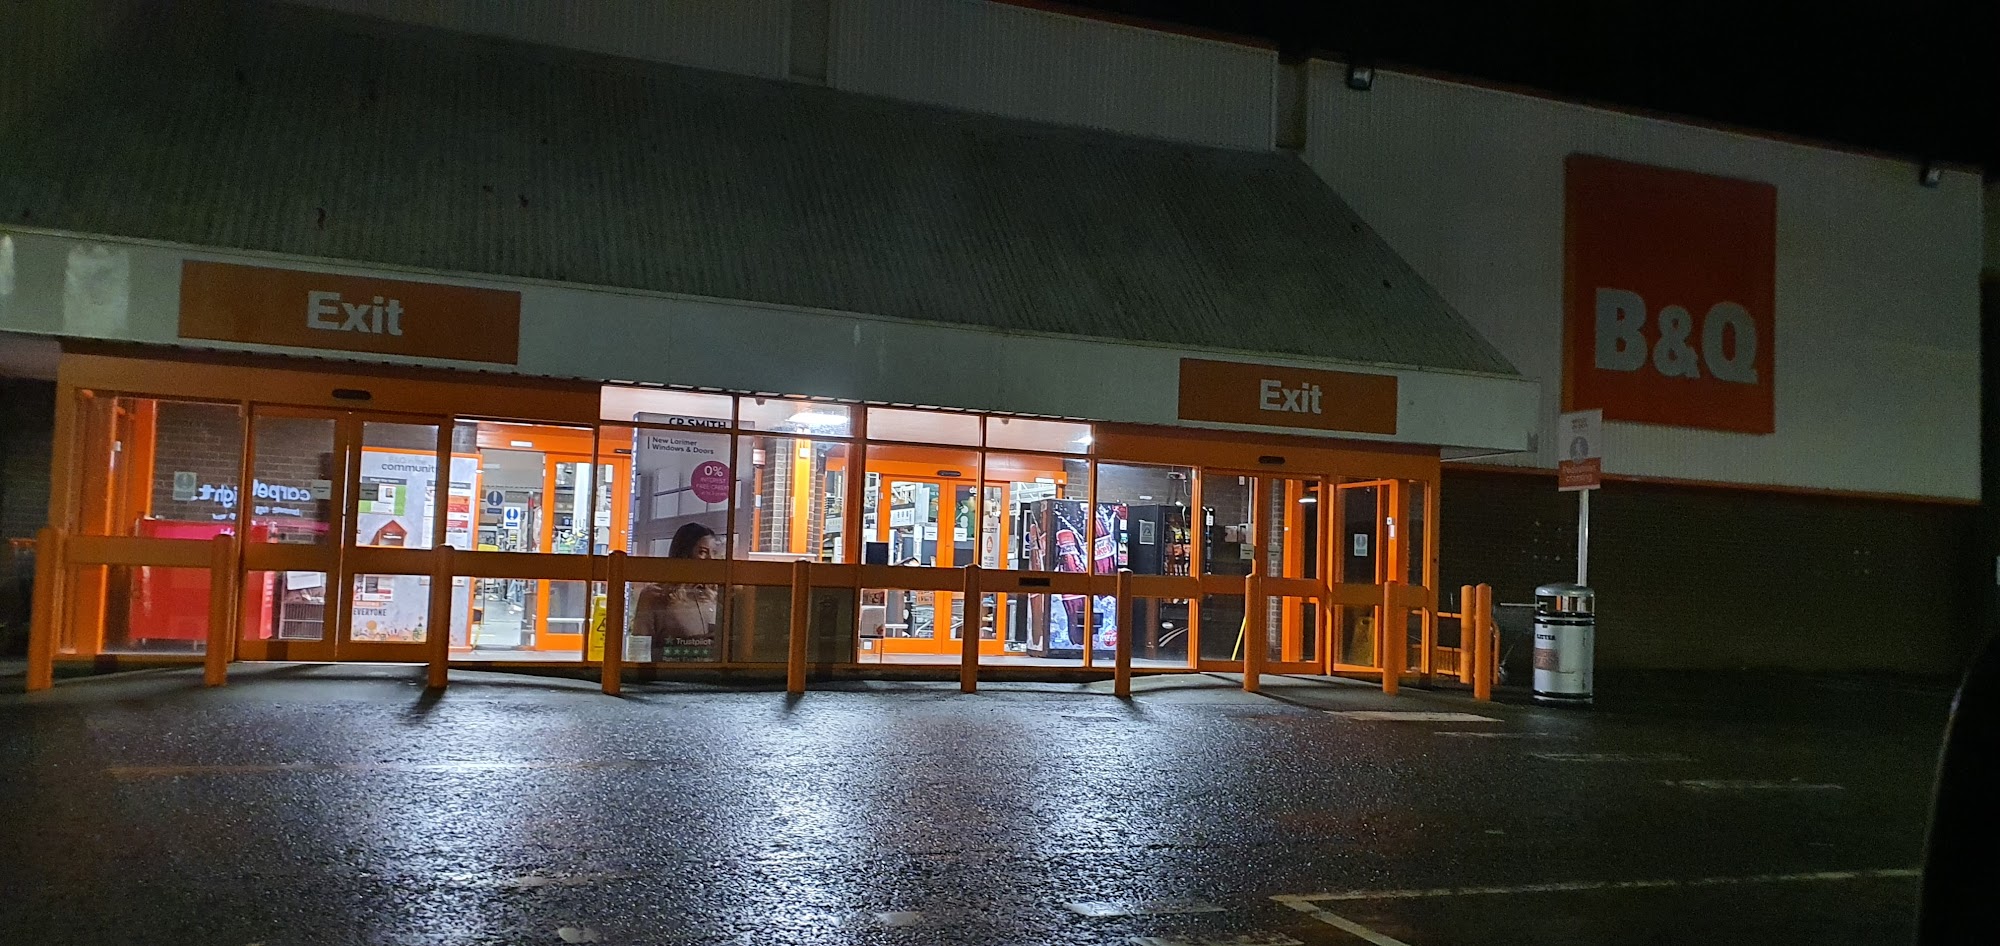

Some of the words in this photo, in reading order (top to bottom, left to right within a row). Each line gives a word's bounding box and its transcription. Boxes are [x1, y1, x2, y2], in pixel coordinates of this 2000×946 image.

[307, 290, 404, 337] Exit
[1594, 287, 1760, 386] B&Q
[1259, 379, 1323, 415] Exit
[688, 419, 727, 429] SMITH
[653, 436, 669, 445] New
[670, 438, 698, 447] Lorimer
[652, 443, 684, 453] Windows
[693, 447, 714, 455] Doors
[381, 462, 436, 473] communit
[704, 465, 724, 477] 0%
[353, 608, 387, 616] EVERYONE
[676, 637, 712, 647] Trustpilot
